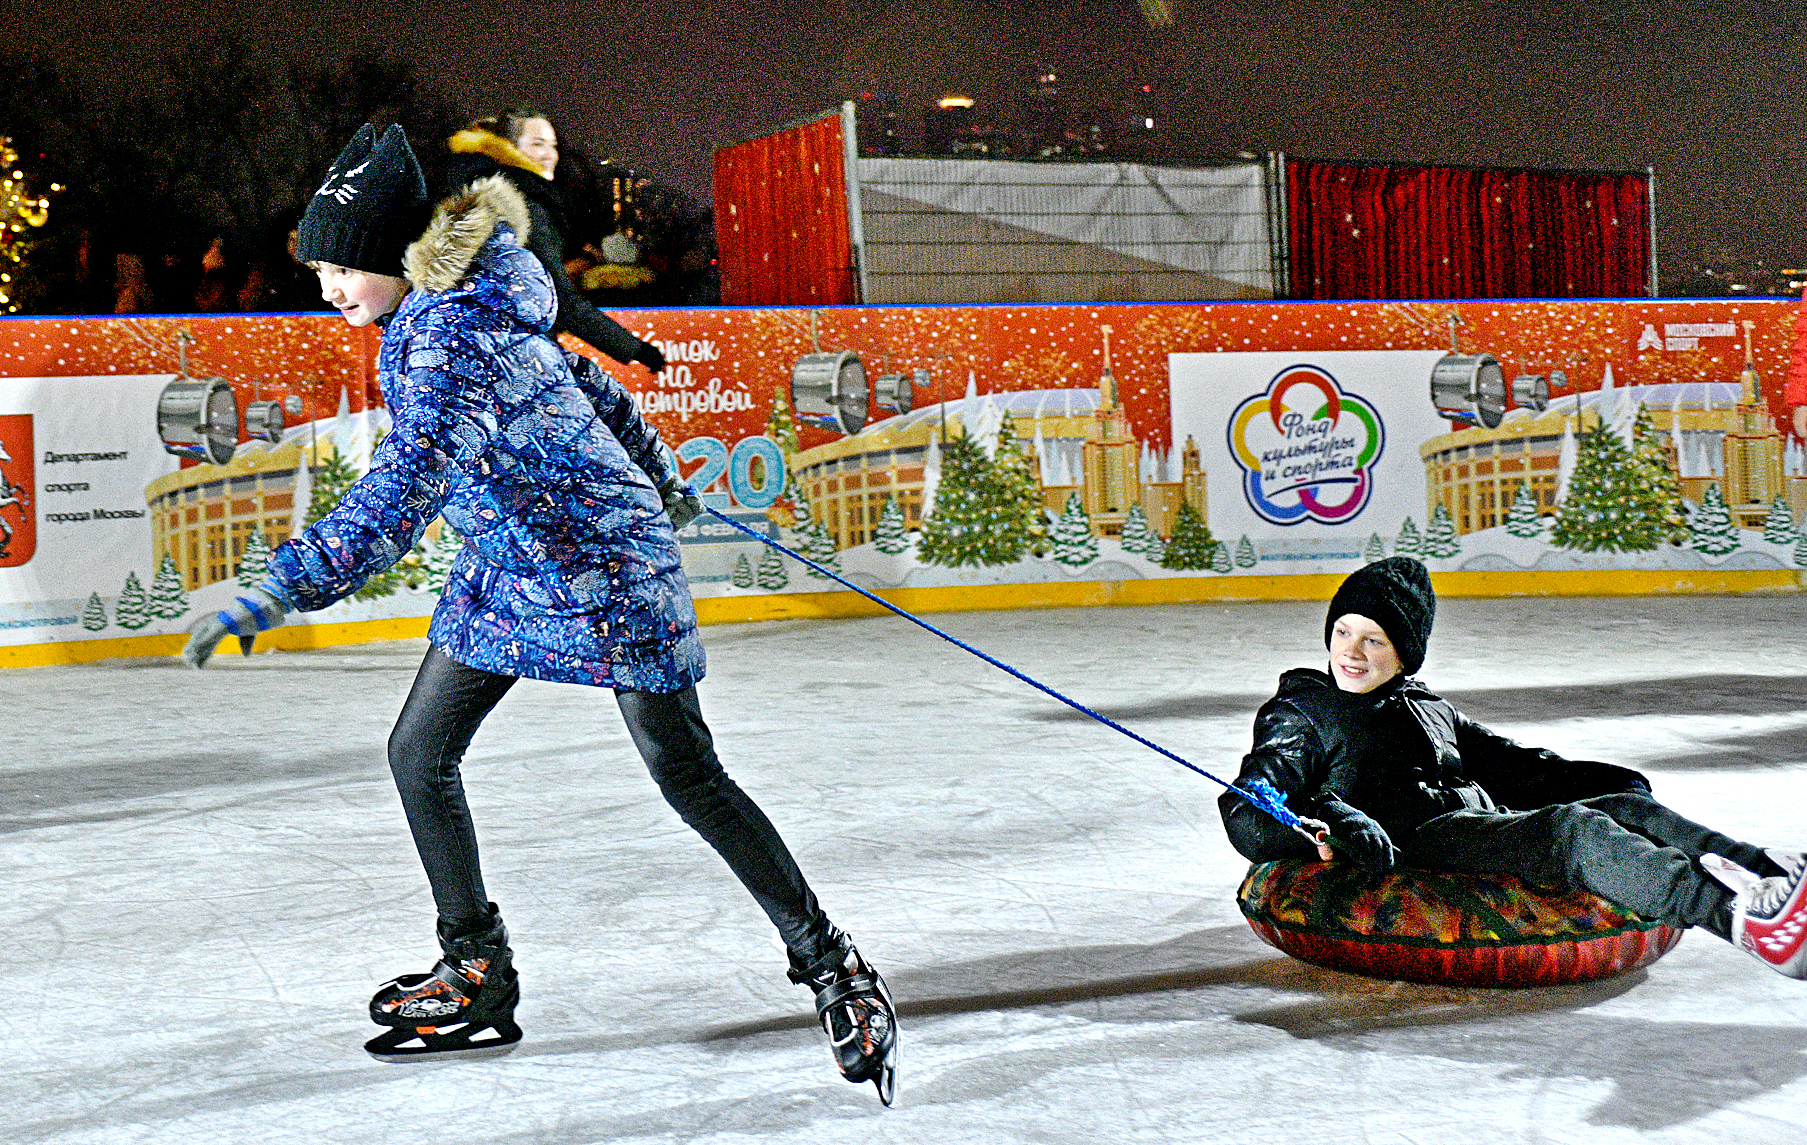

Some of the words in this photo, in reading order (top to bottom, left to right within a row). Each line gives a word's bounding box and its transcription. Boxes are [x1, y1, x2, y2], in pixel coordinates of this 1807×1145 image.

[658, 365, 697, 388] на
[1282, 412, 1330, 439] Фонд
[43, 451, 128, 465] Департамент
[1261, 437, 1356, 466] культуры
[1264, 469, 1277, 481] и
[1282, 453, 1354, 480] спорта
[44, 482, 90, 494] спорта
[45, 512, 91, 525] города
[93, 508, 146, 520] Москвы
